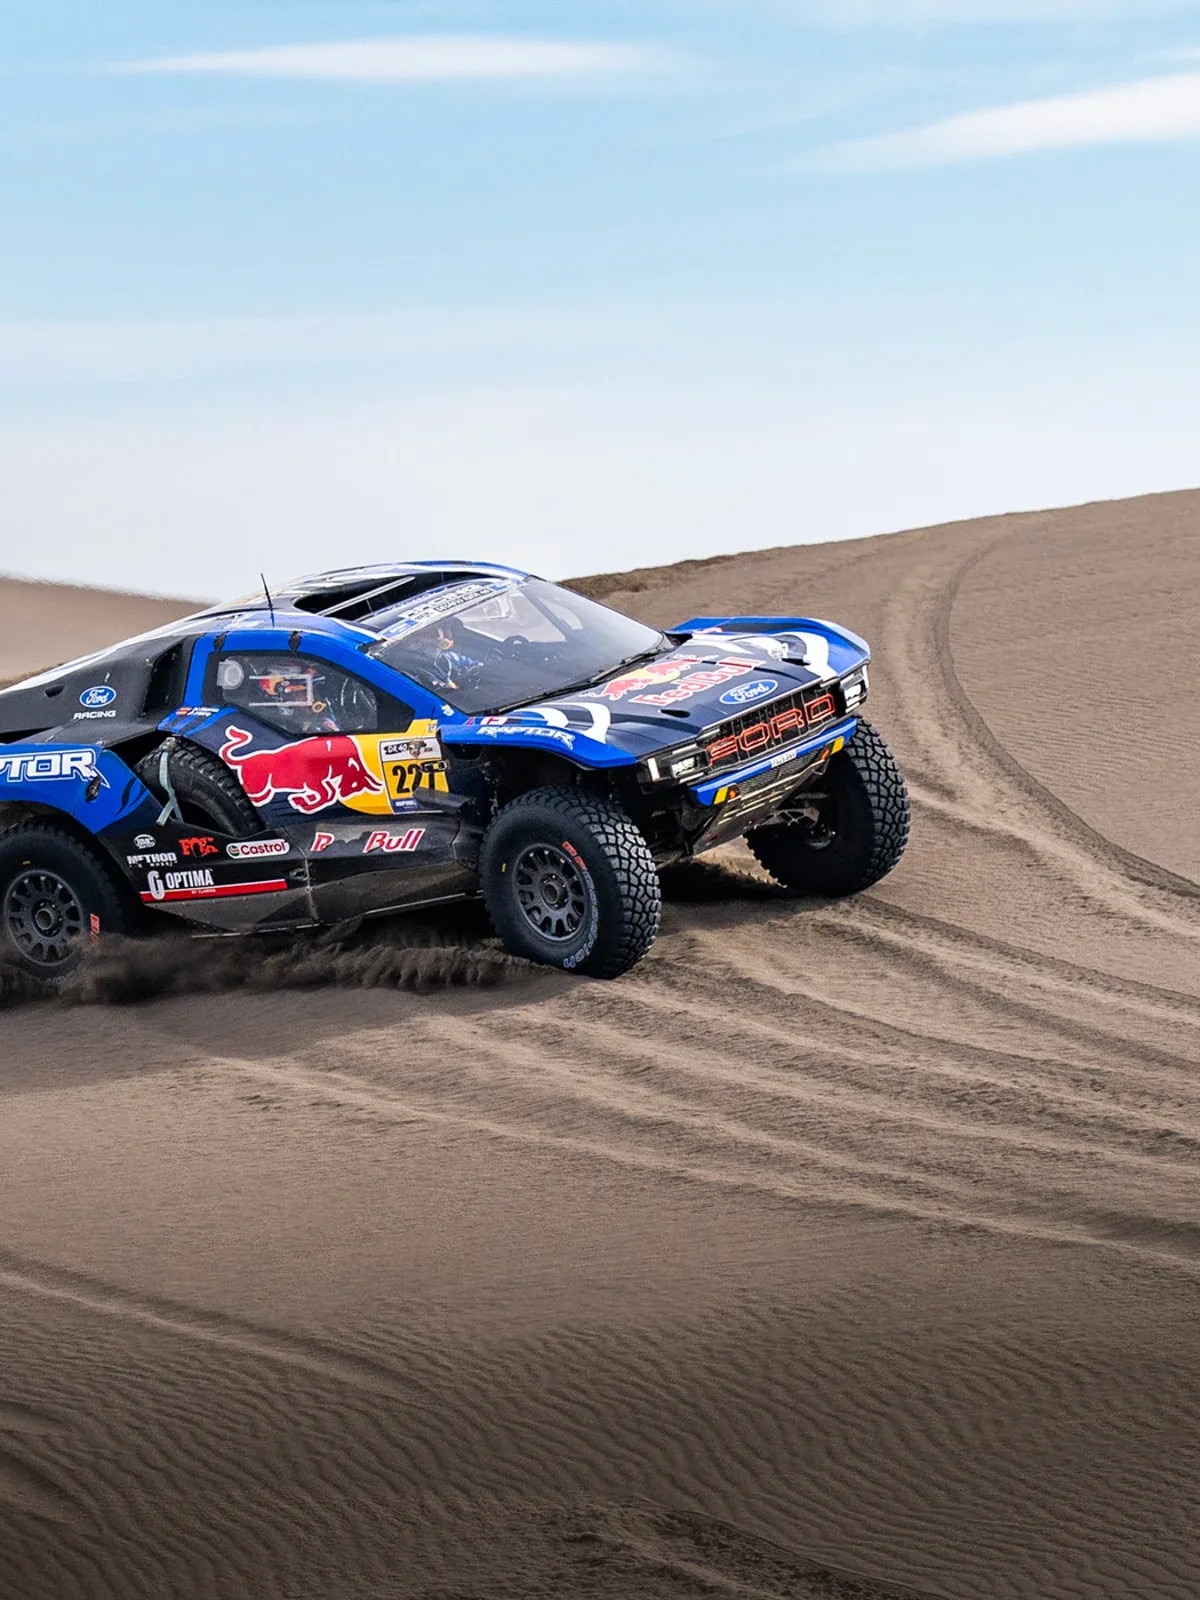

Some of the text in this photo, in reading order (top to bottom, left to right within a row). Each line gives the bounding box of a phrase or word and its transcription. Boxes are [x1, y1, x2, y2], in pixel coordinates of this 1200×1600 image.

[72, 710, 117, 720] RACING
[476, 726, 576, 750] RAPTOR
[704, 693, 836, 768] FORD
[240, 842, 286, 856] Castrol
[362, 828, 426, 853] Bull
[126, 852, 178, 865] METHOD
[165, 869, 214, 889] OPTIMA
